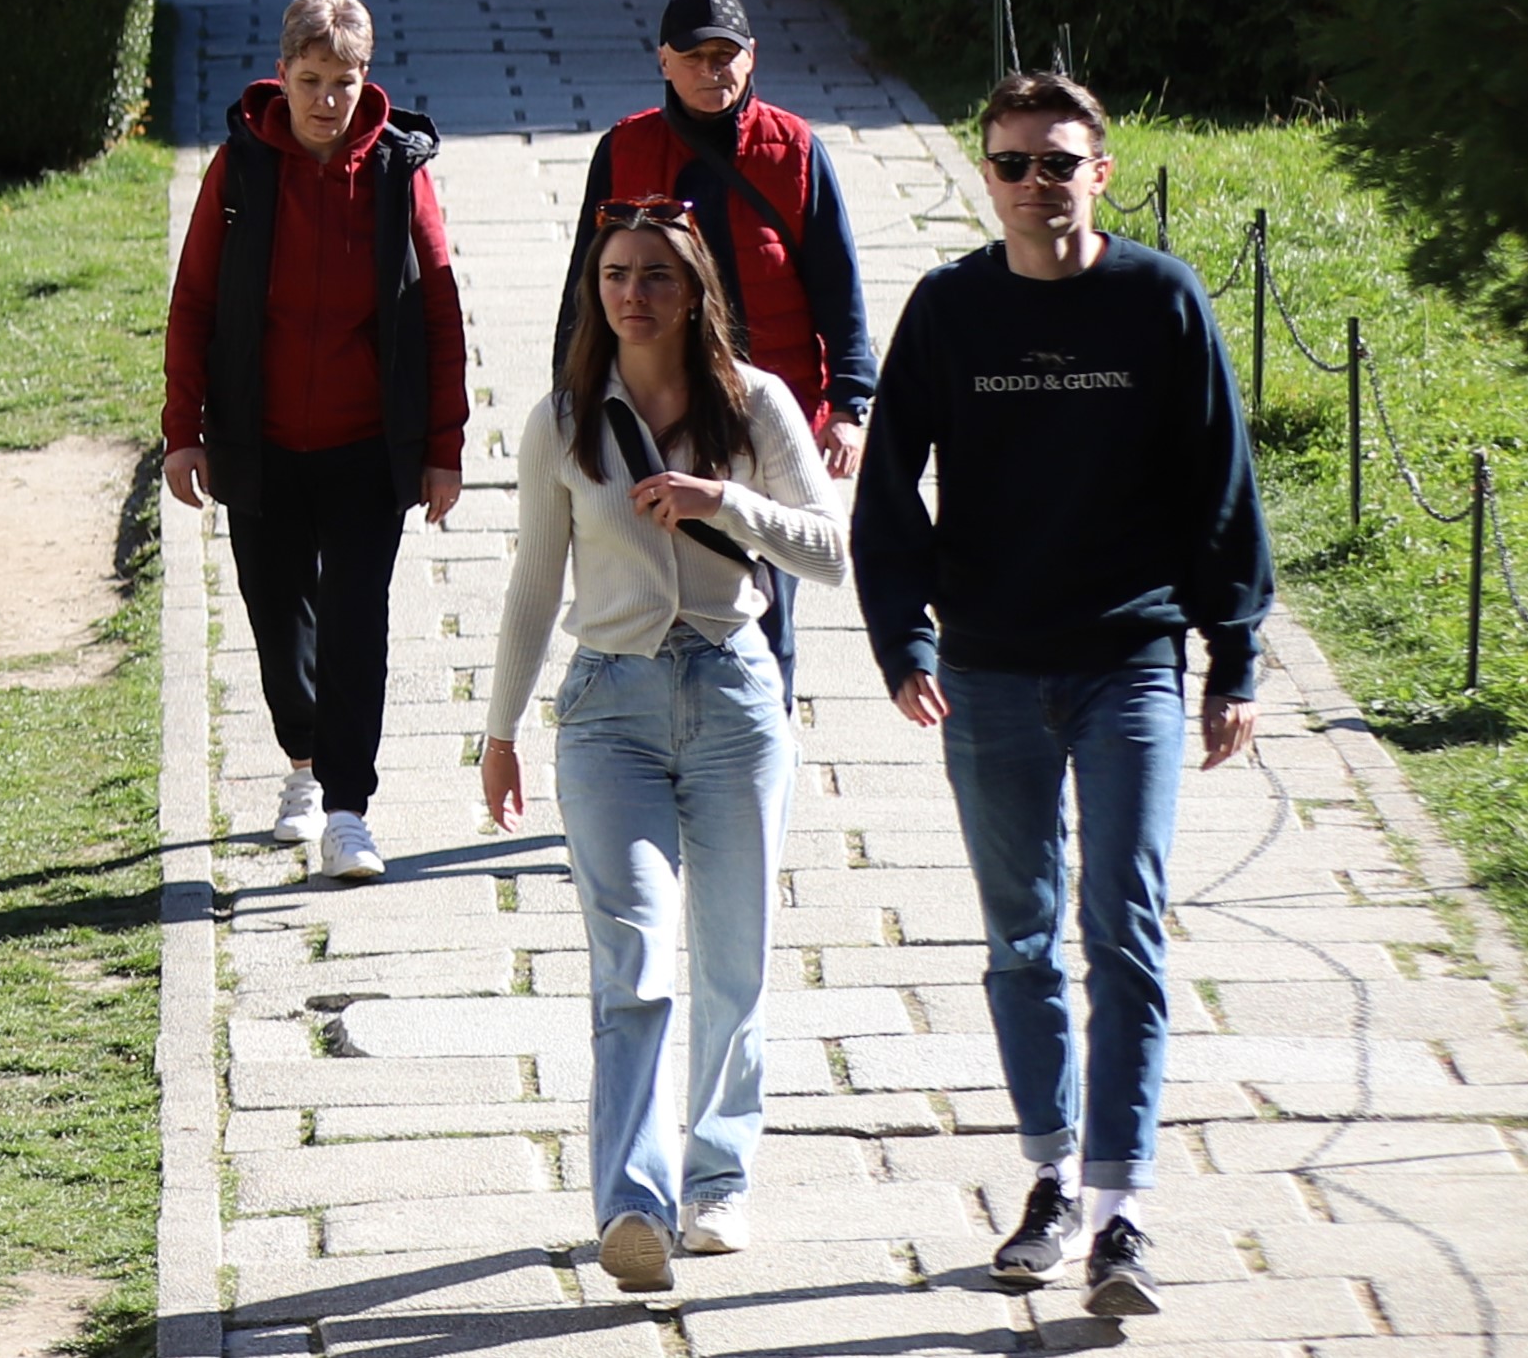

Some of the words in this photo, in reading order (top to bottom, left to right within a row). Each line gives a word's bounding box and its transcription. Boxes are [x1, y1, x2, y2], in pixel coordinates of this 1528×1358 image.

[974, 375, 1040, 392] RODD
[1043, 374, 1062, 390] &
[1063, 371, 1130, 390] GUNN
